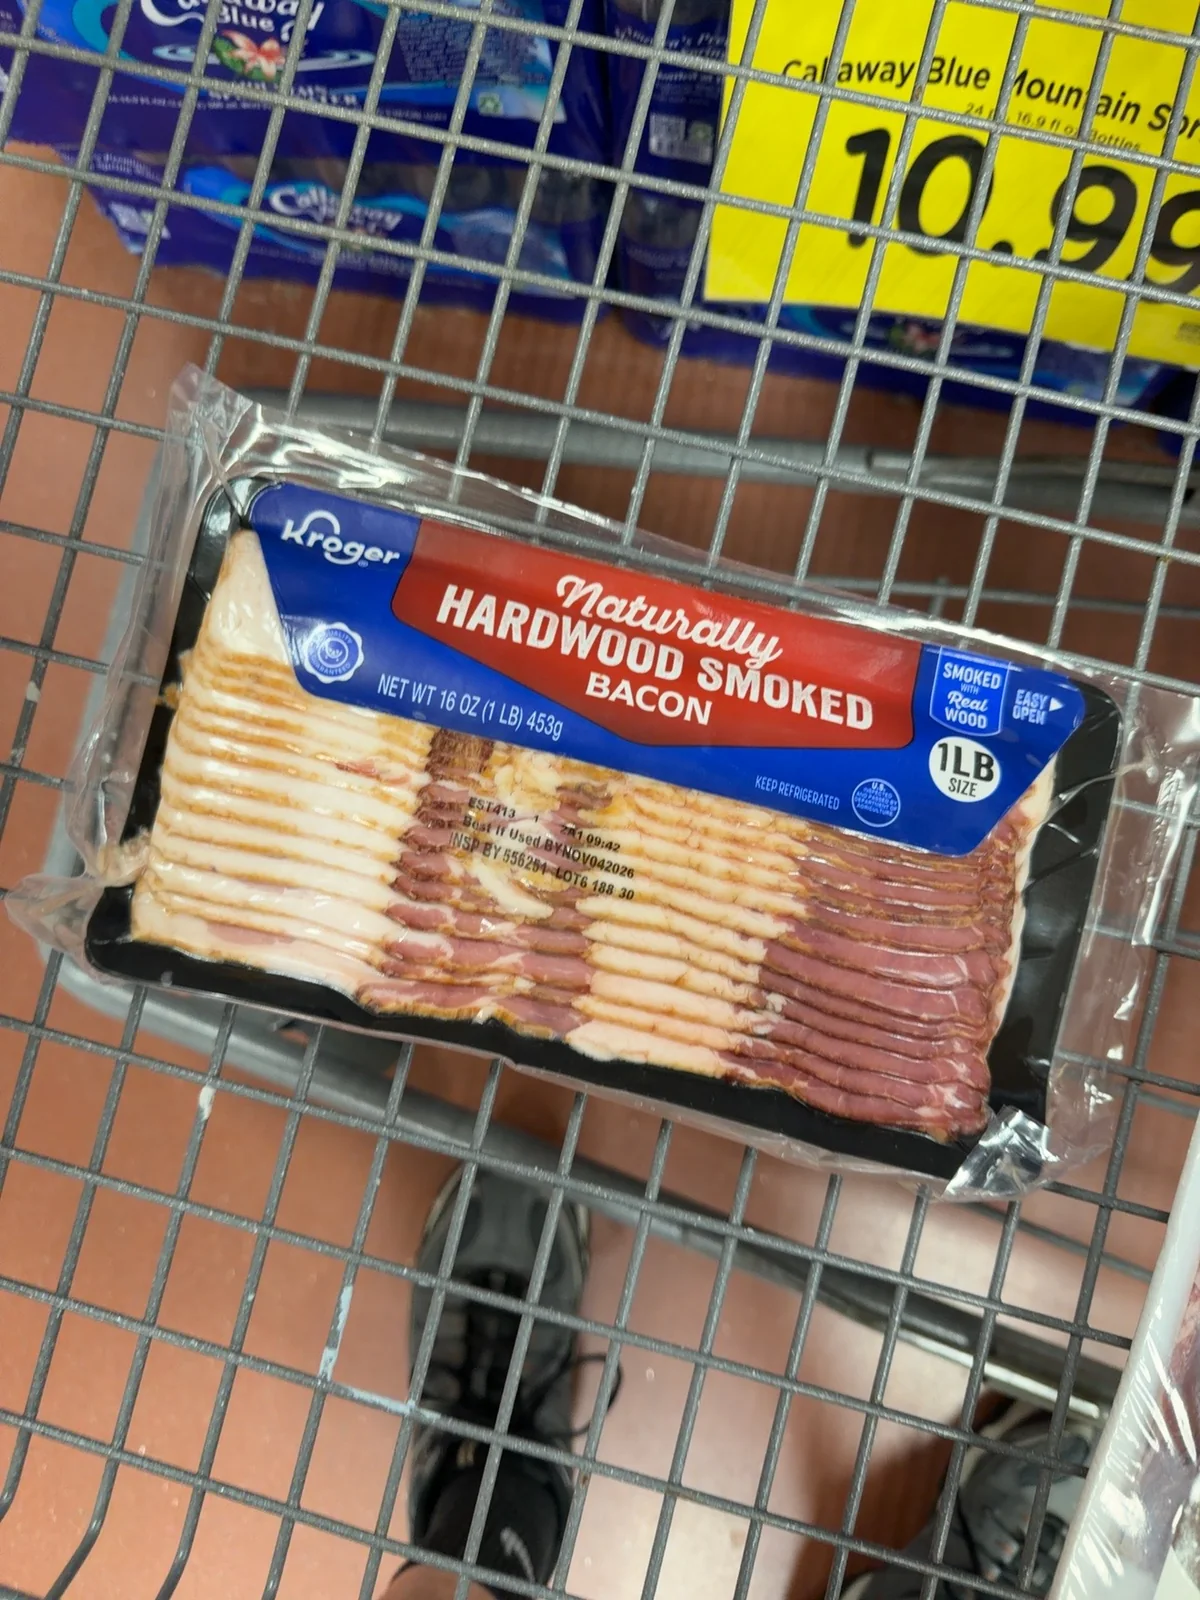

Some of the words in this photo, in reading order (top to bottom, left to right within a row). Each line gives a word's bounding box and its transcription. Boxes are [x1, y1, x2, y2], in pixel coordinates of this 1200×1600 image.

[781, 55, 916, 89] Calaway
[927, 56, 991, 90] Blue
[1012, 68, 1141, 125] ounain
[966, 103, 984, 117] 24
[846, 128, 1200, 303] 10.99
[281, 509, 400, 565] Kroger
[556, 575, 783, 667] Naturally
[436, 583, 684, 681] HARDWOOD
[697, 657, 873, 731] SMOKED
[942, 662, 1001, 690] SMOKED
[960, 683, 979, 695] WITH
[377, 673, 409, 701] NET
[412, 684, 437, 706] WT
[440, 688, 455, 711] 16
[459, 693, 481, 717] OZ
[481, 700, 496, 724] (1
[499, 706, 524, 732] LB)
[526, 714, 563, 741] 453g
[585, 672, 713, 726] BACON
[947, 690, 988, 713] Real
[1012, 705, 1047, 725] OPEN
[1015, 689, 1049, 710] EASY
[944, 706, 988, 729] WOOD
[755, 775, 778, 790] KEEP
[778, 781, 840, 811] REFRIGERATED
[948, 777, 978, 797] SIZE
[463, 815, 491, 834] Best
[496, 825, 505, 837] If
[509, 827, 541, 848] Used
[468, 796, 516, 819] EST413
[586, 833, 621, 854] 09:42
[449, 831, 480, 855] INSP
[482, 843, 506, 861] BY
[592, 879, 615, 897] 188
[620, 887, 635, 902] 30
